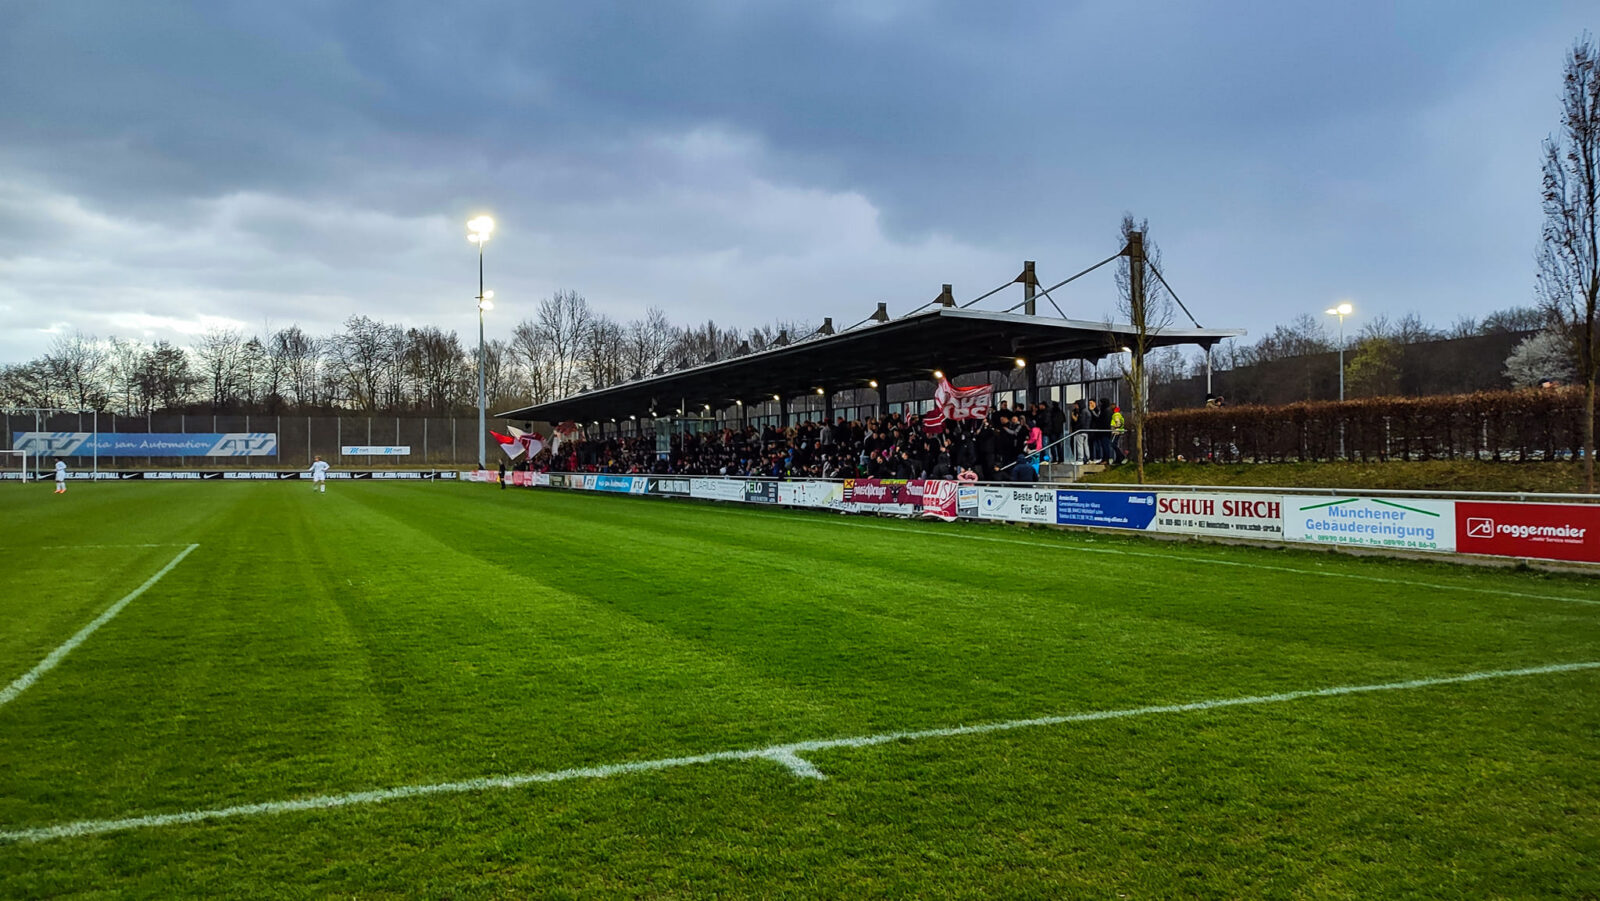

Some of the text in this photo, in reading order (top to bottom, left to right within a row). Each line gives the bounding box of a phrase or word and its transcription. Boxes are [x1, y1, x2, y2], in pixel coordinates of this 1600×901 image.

[139, 439, 212, 449] Automation
[1013, 490, 1032, 501] Beste
[1034, 492, 1054, 504] Optik
[1020, 504, 1031, 515] Für
[1034, 505, 1047, 516] Sie!
[1159, 498, 1281, 519] SCHUH SIRCH
[1328, 506, 1406, 520] Münchener
[1305, 519, 1435, 540] Gebäudereinigung
[1496, 524, 1587, 538] roggermaier
